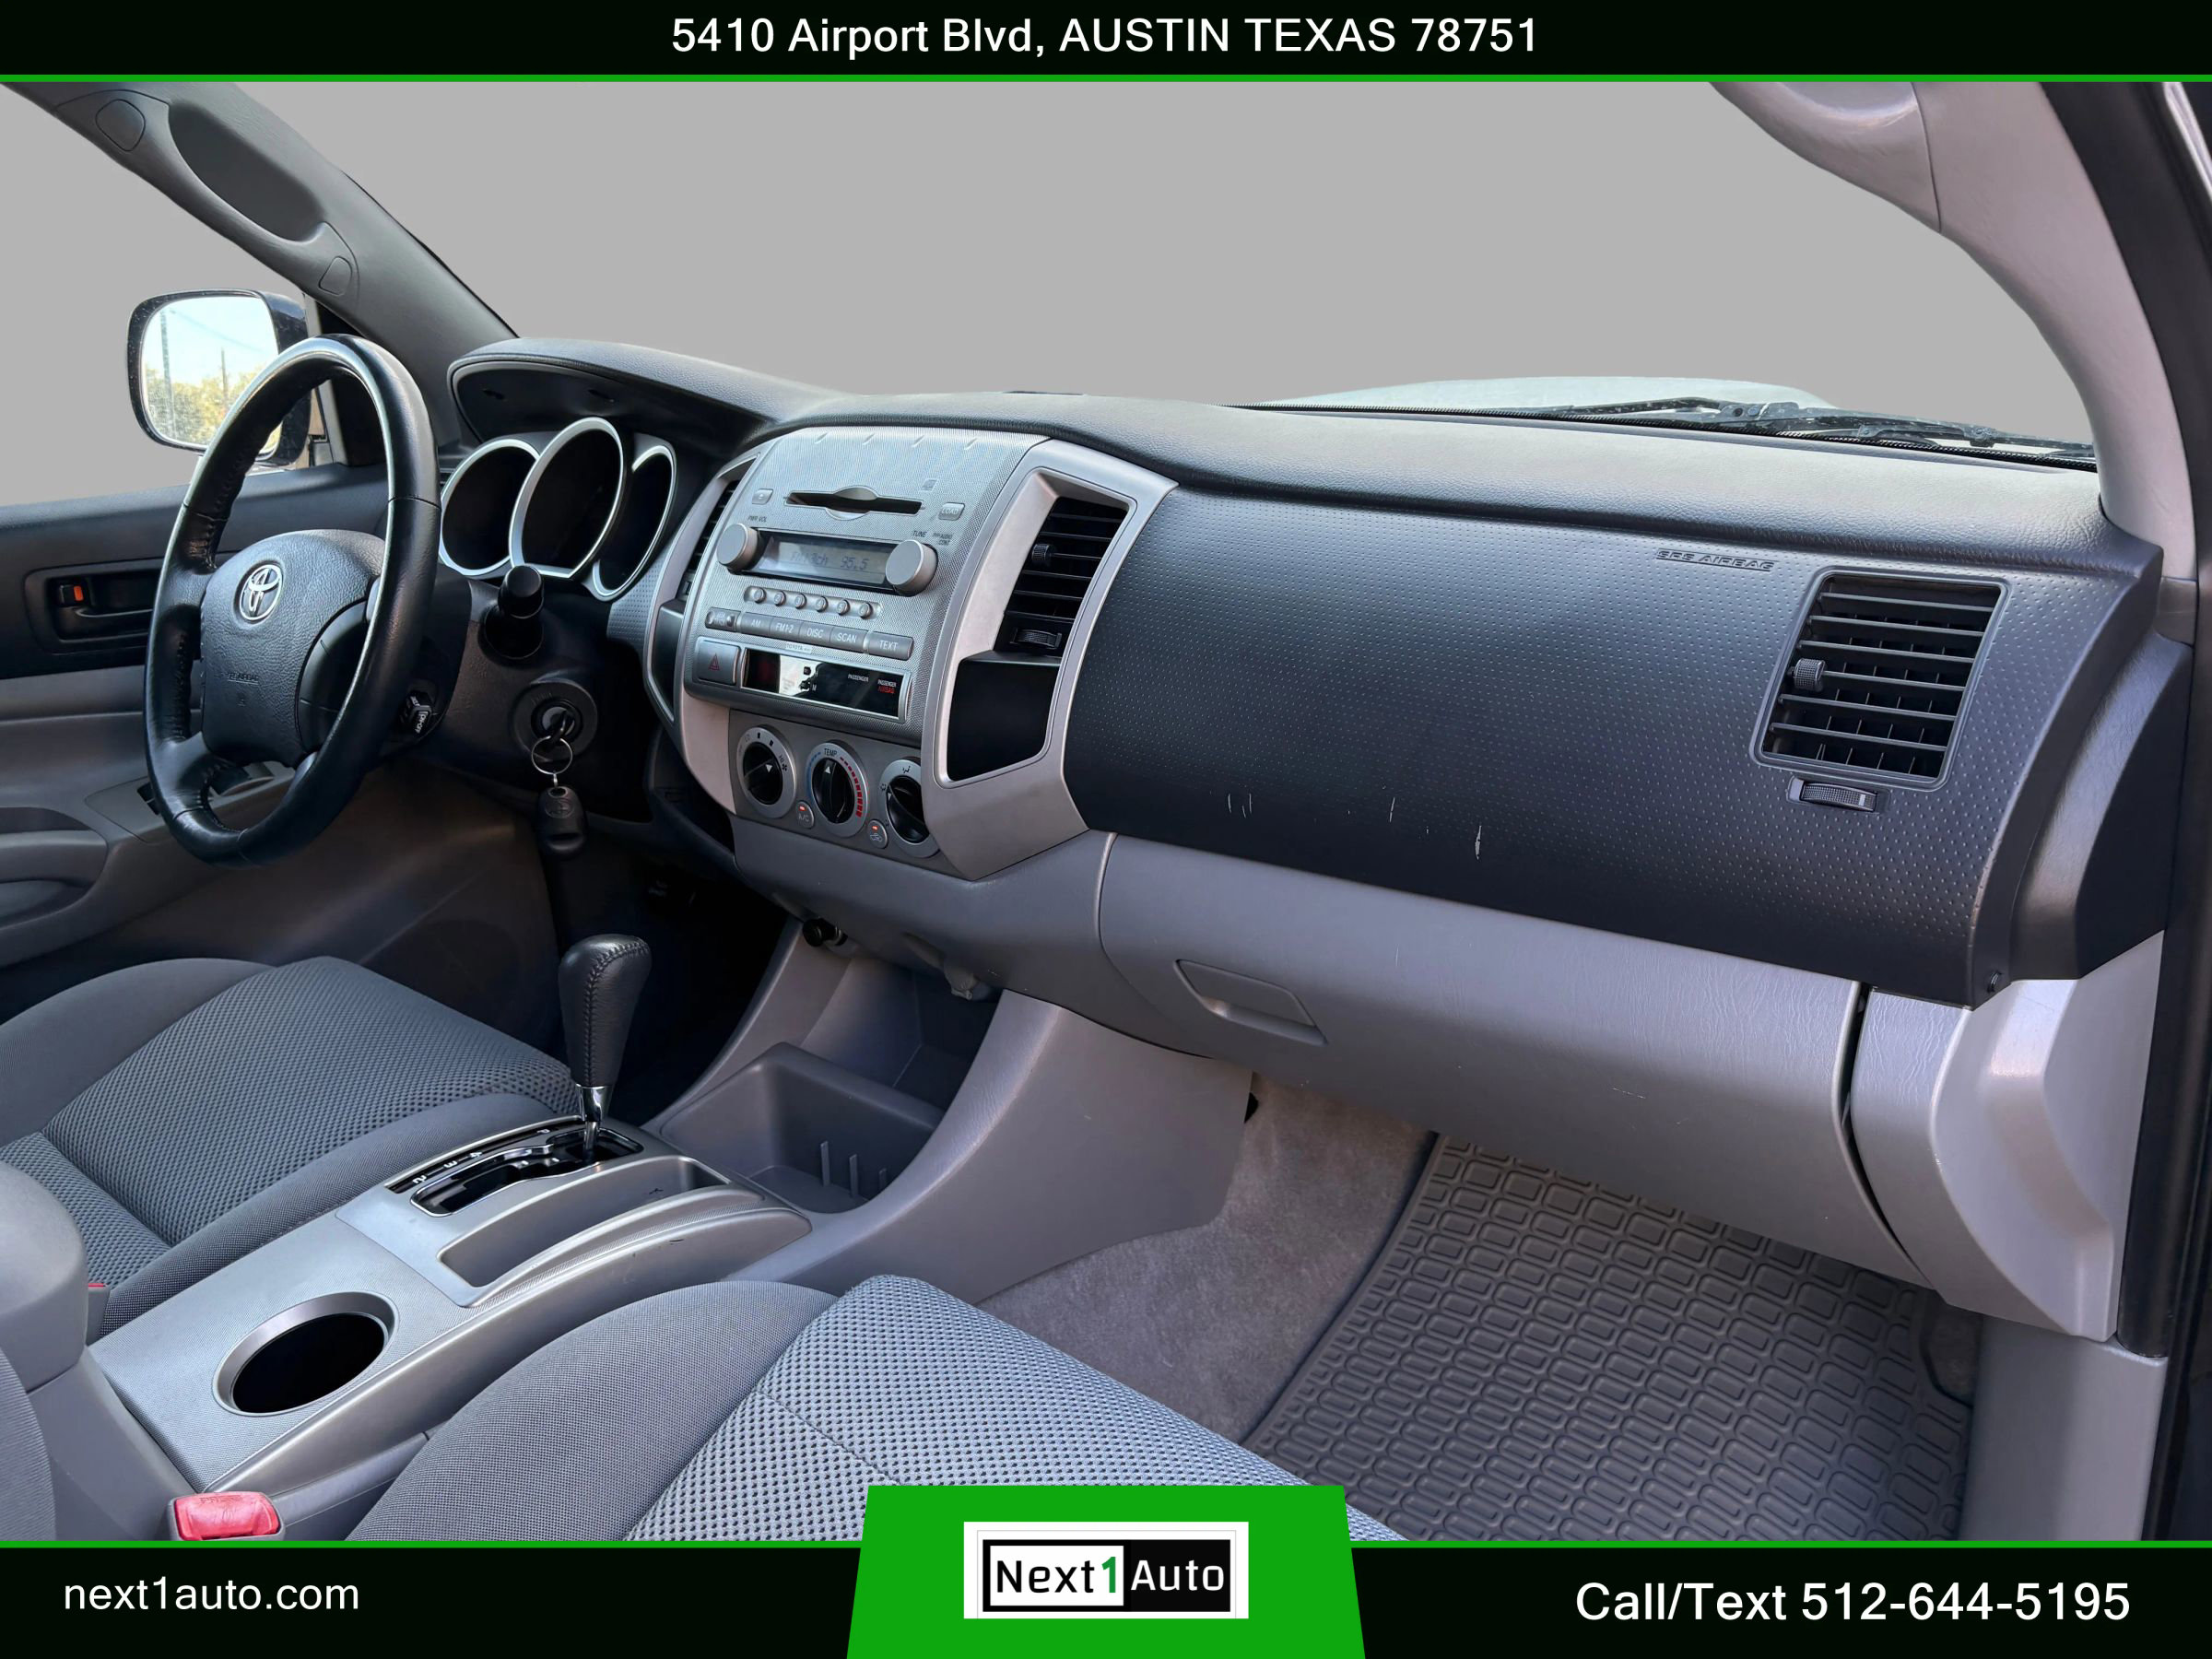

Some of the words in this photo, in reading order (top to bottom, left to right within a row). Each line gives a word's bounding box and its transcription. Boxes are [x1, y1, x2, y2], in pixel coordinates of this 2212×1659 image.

[912, 530, 927, 538] TUNE
[1657, 550, 1695, 561] SRS
[1698, 555, 1775, 570] AIRBAG
[806, 629, 824, 639] DISC
[837, 632, 857, 643] SCAN
[879, 640, 899, 651] TEXT
[824, 747, 838, 757] TEMP
[798, 813, 809, 823] A/C
[443, 1159, 458, 1169] 3
[412, 1174, 428, 1184] 2
